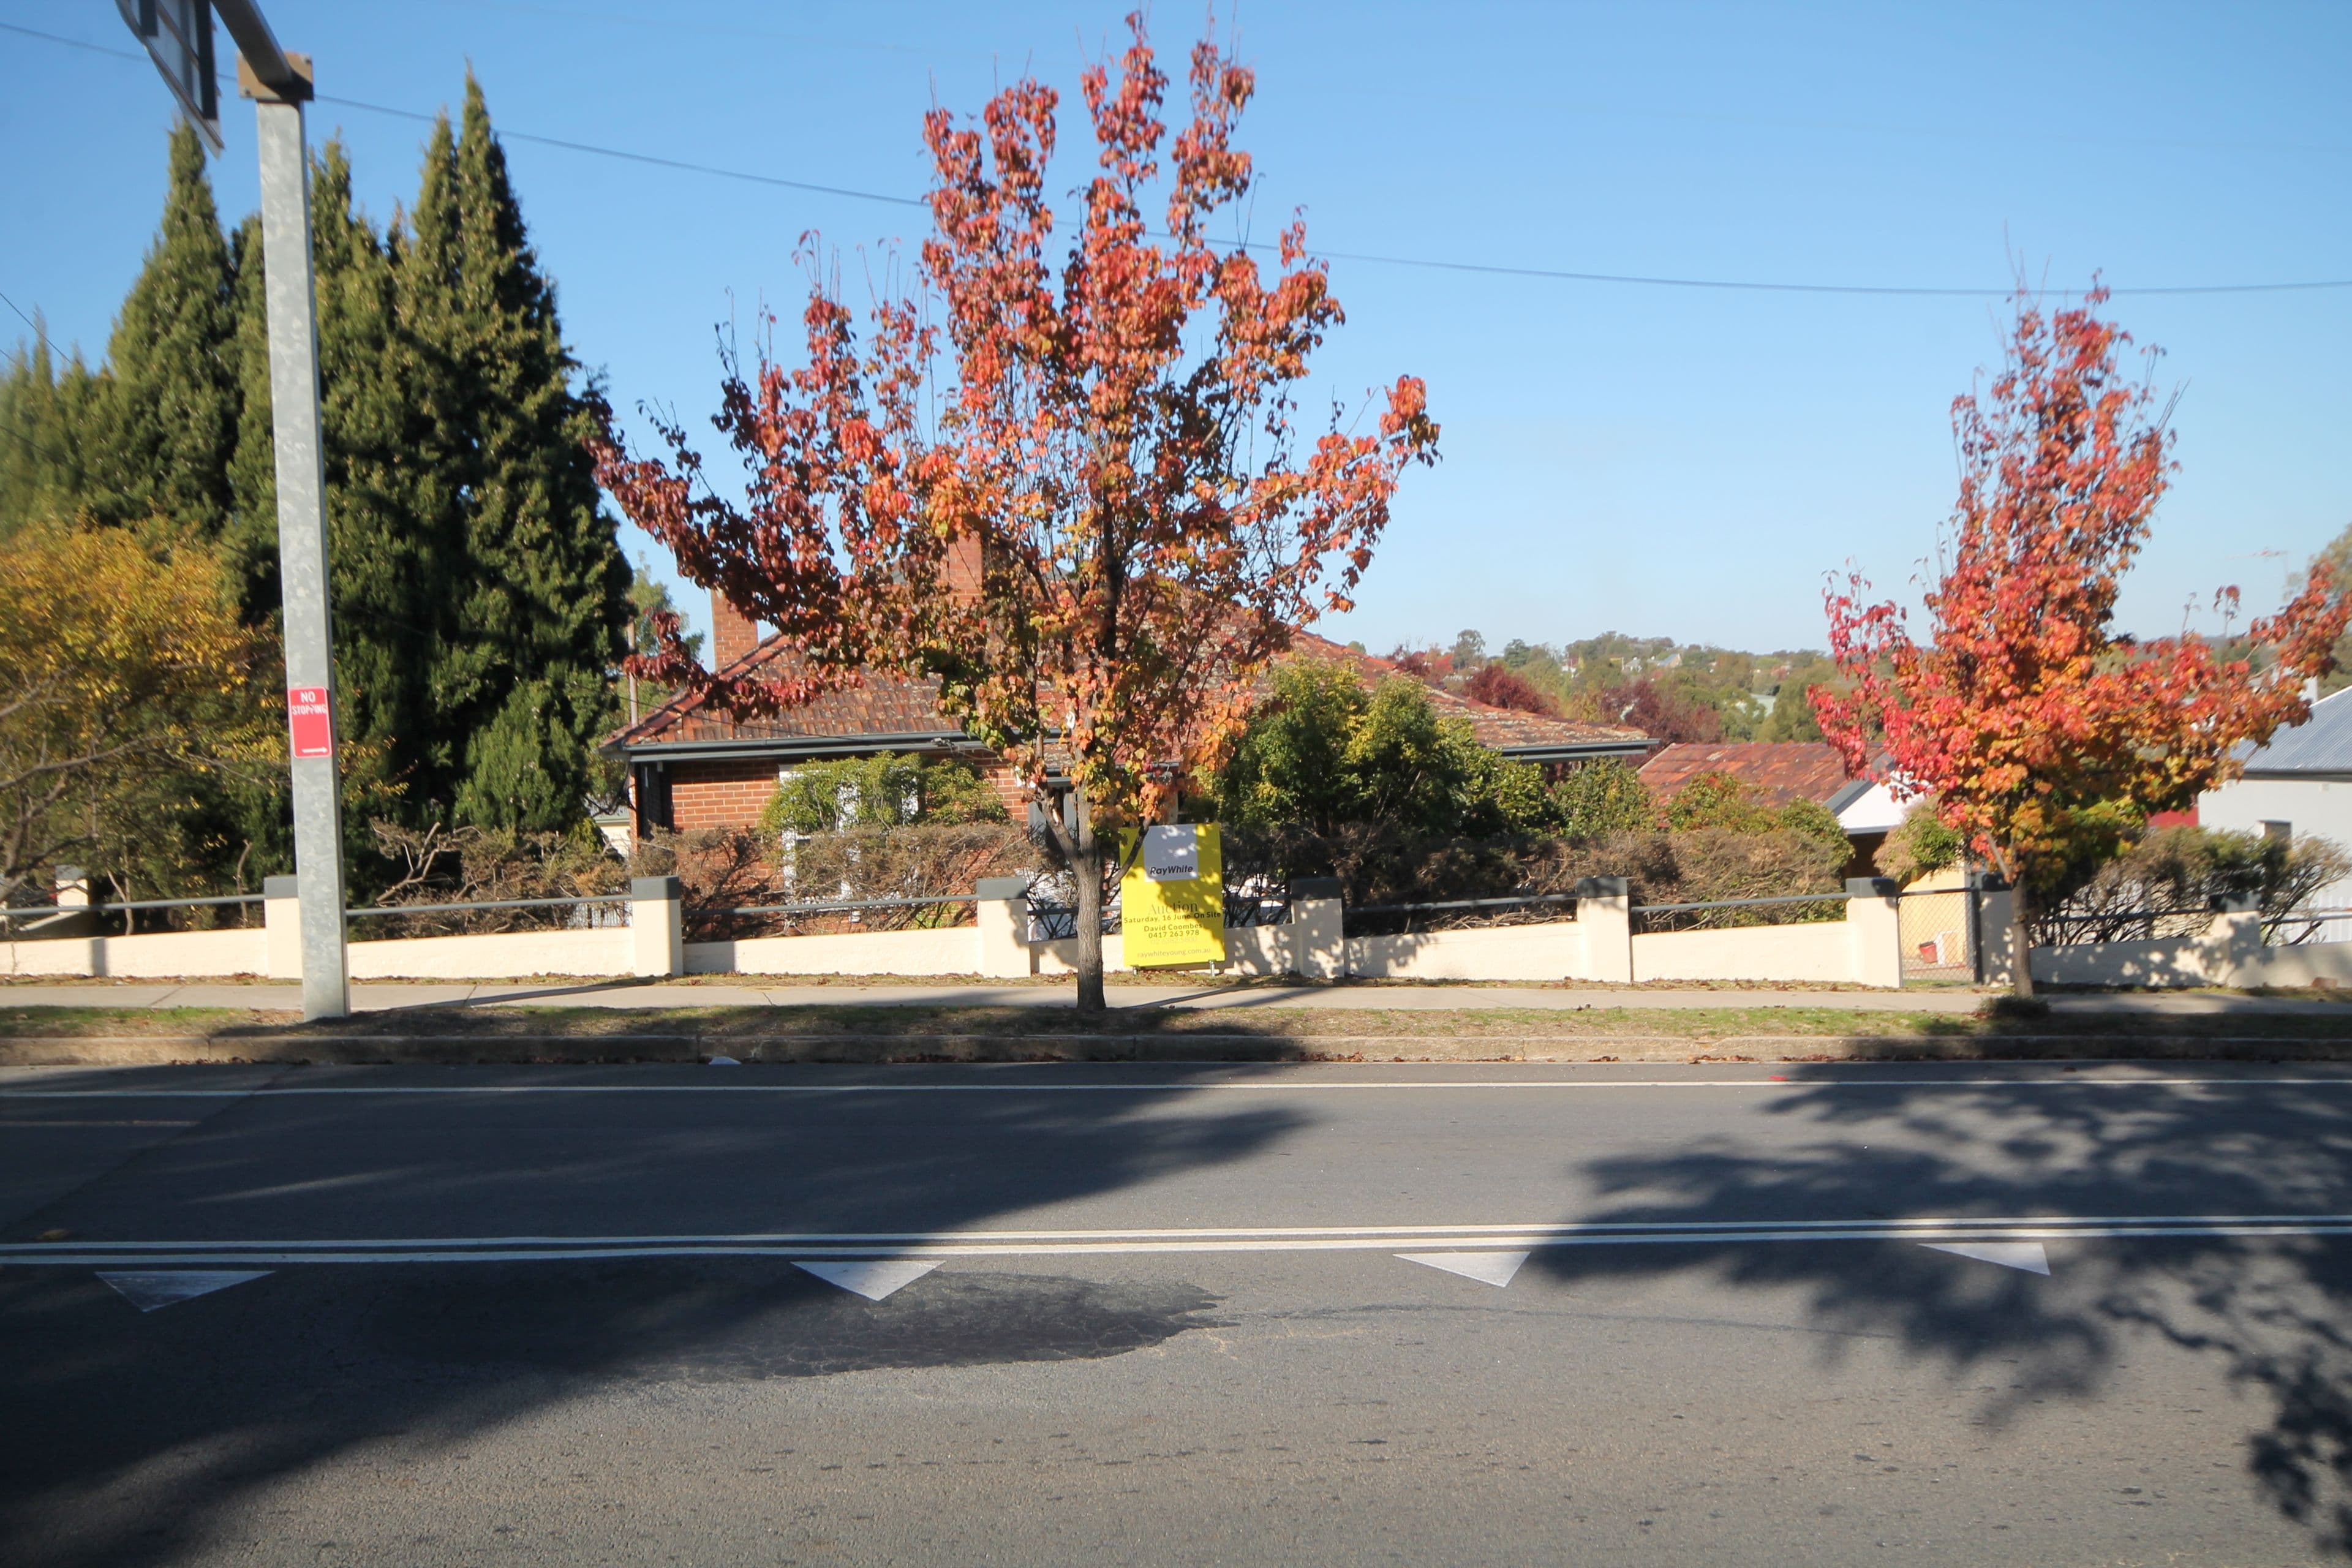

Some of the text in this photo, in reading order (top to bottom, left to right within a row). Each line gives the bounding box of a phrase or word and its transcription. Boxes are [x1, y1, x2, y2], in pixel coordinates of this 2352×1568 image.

[300, 691, 315, 703] NO
[292, 704, 327, 715] STOPPING
[1148, 901, 1199, 914] Auction
[1137, 948, 1211, 958] raywhiteyoung.com.au
